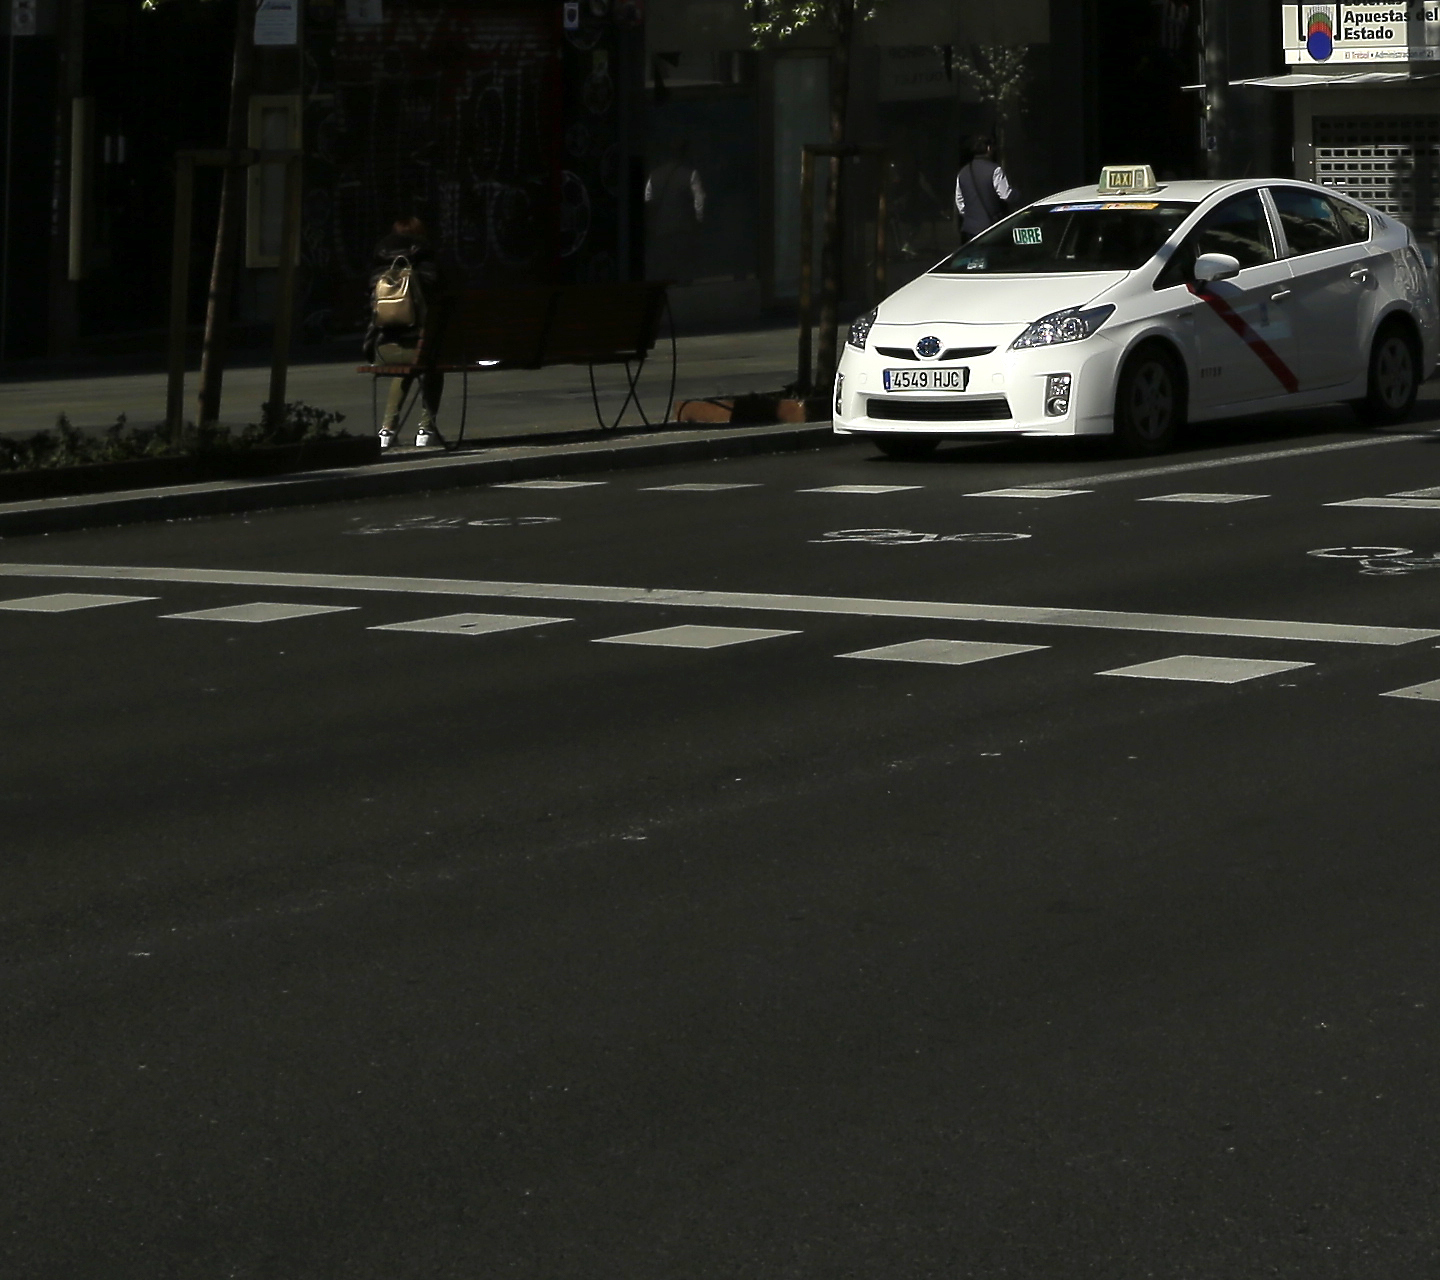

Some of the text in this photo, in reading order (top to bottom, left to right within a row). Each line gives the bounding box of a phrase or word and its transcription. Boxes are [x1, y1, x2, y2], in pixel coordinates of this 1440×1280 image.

[1344, 7, 1438, 26] Apuestas del
[1344, 26, 1394, 40] Estado
[1110, 171, 1132, 187] TAXI
[1013, 228, 1042, 244] LIBRE
[893, 370, 960, 388] 4549 HJC
